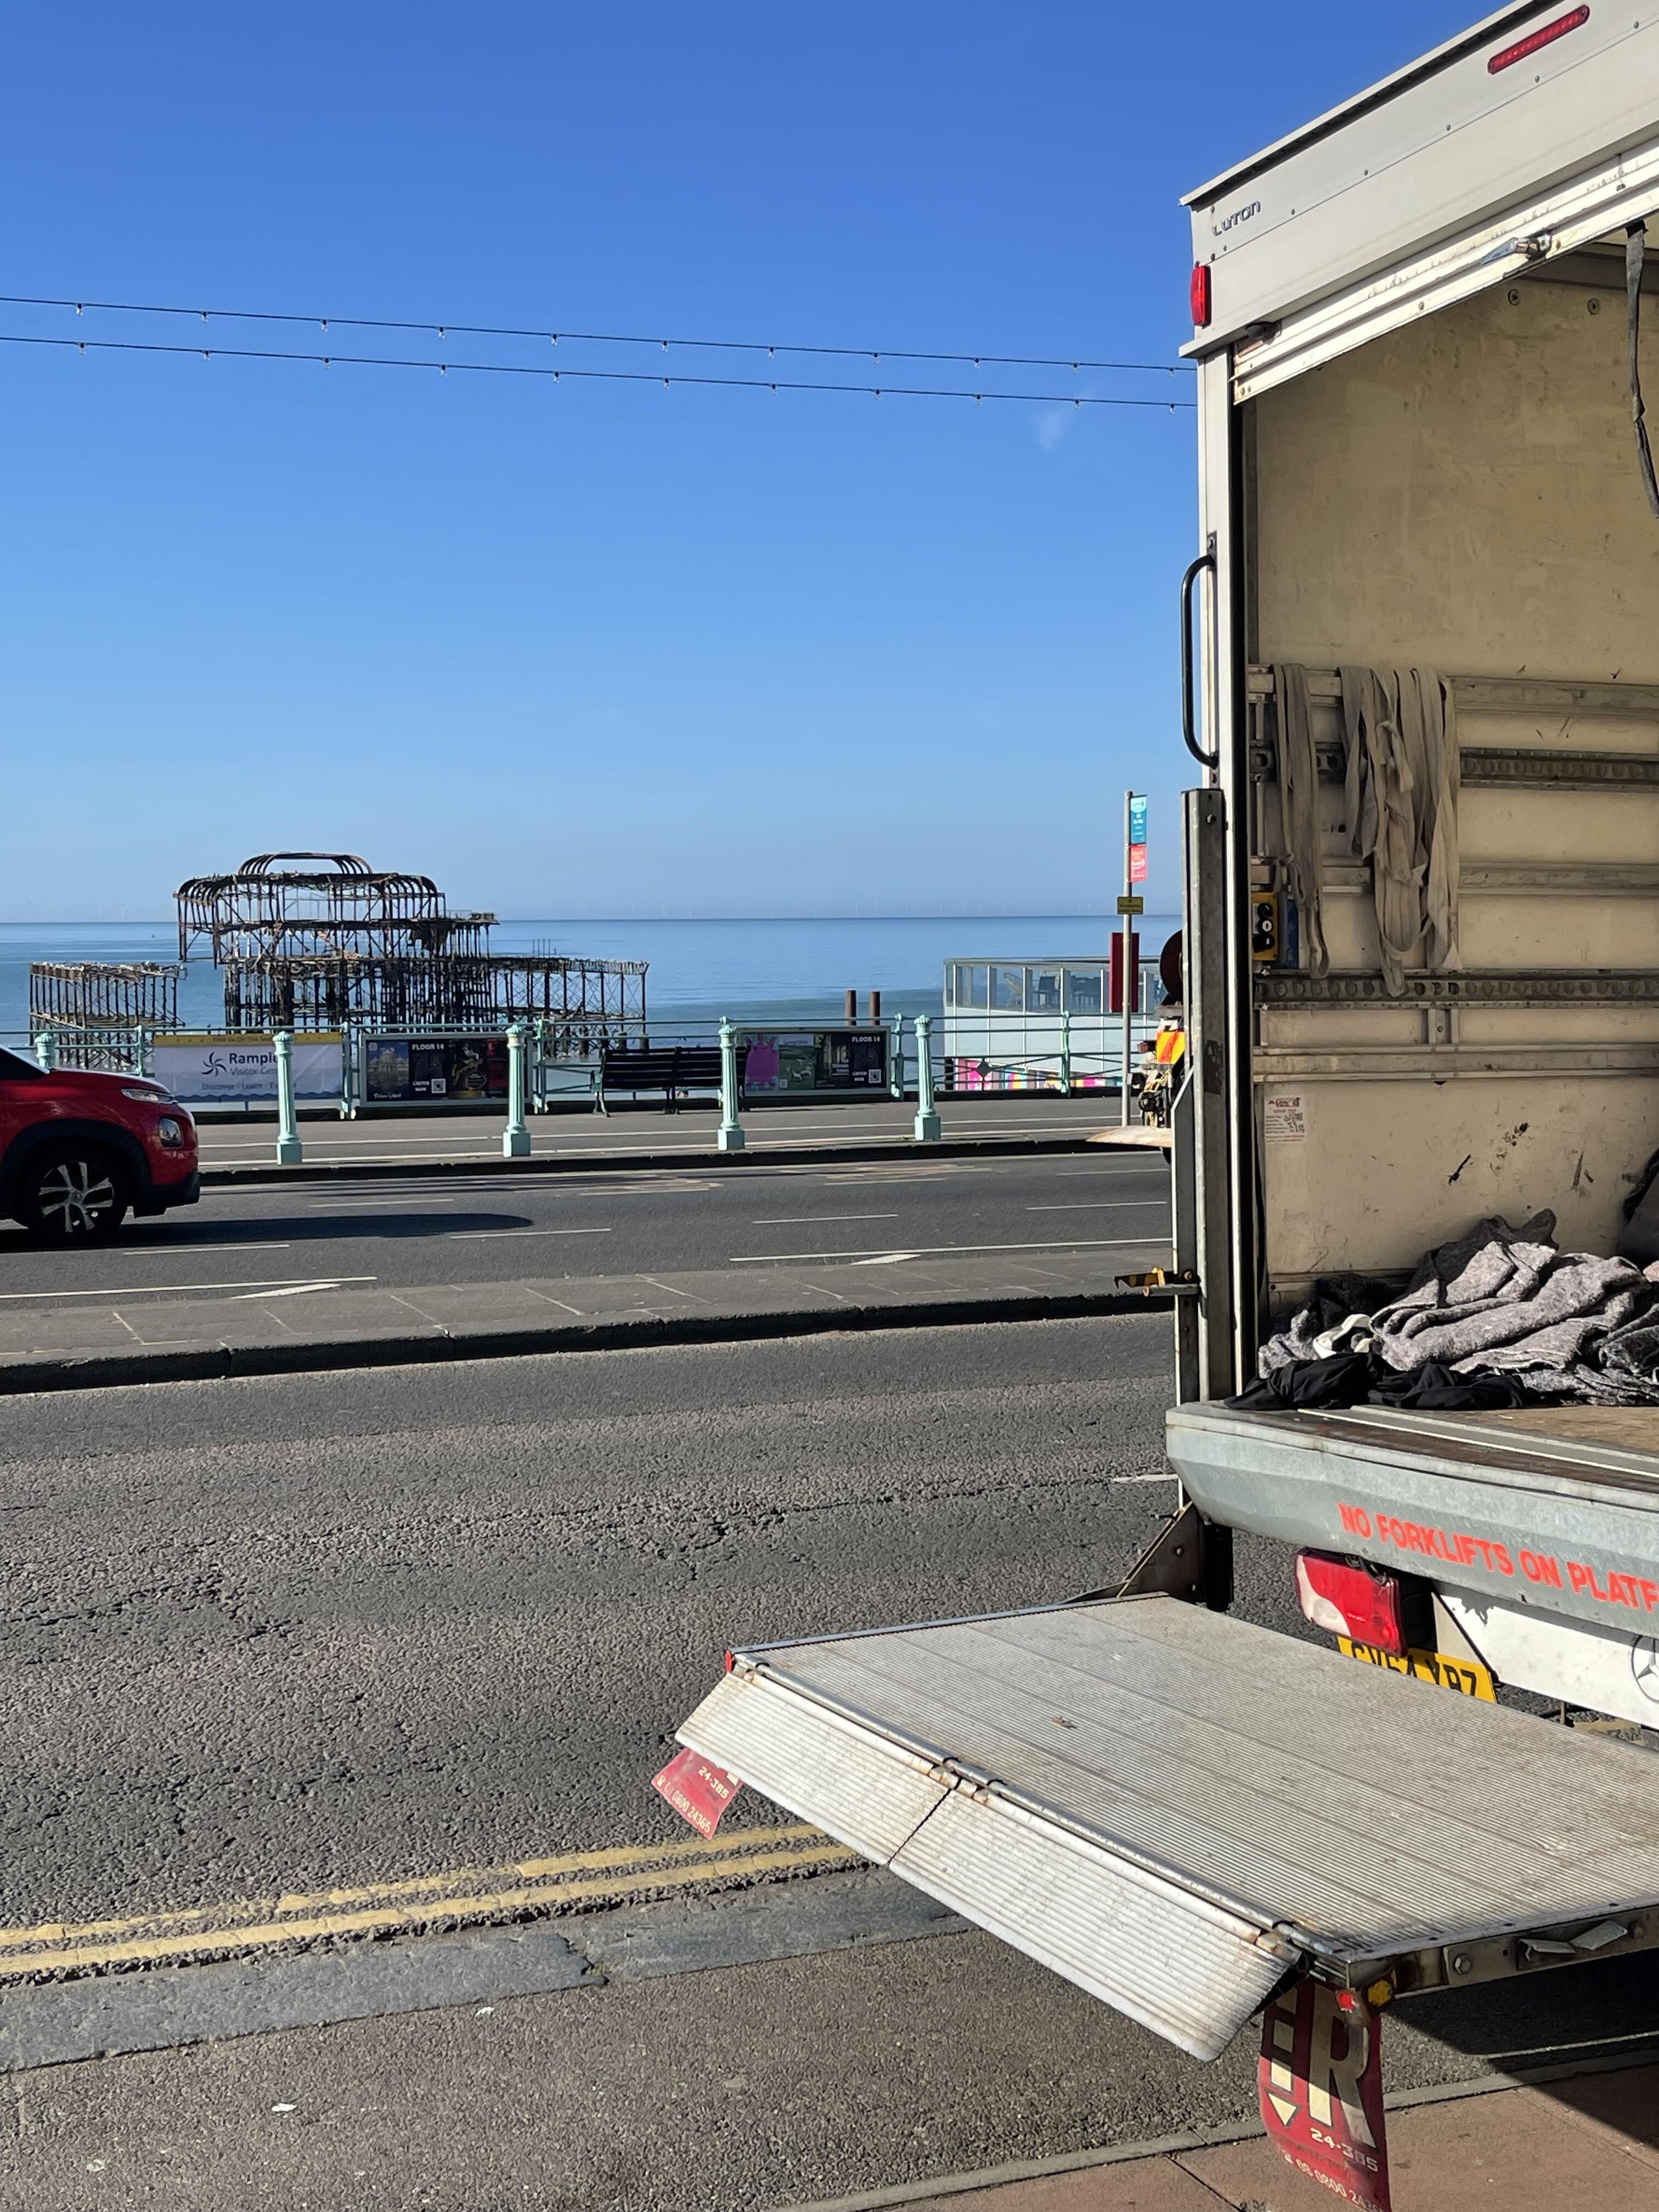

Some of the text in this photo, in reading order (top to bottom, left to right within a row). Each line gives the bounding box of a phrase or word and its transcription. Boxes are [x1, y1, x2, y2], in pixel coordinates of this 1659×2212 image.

[1337, 1502, 1659, 1613] NO FORKLIFTS ON PLATF
